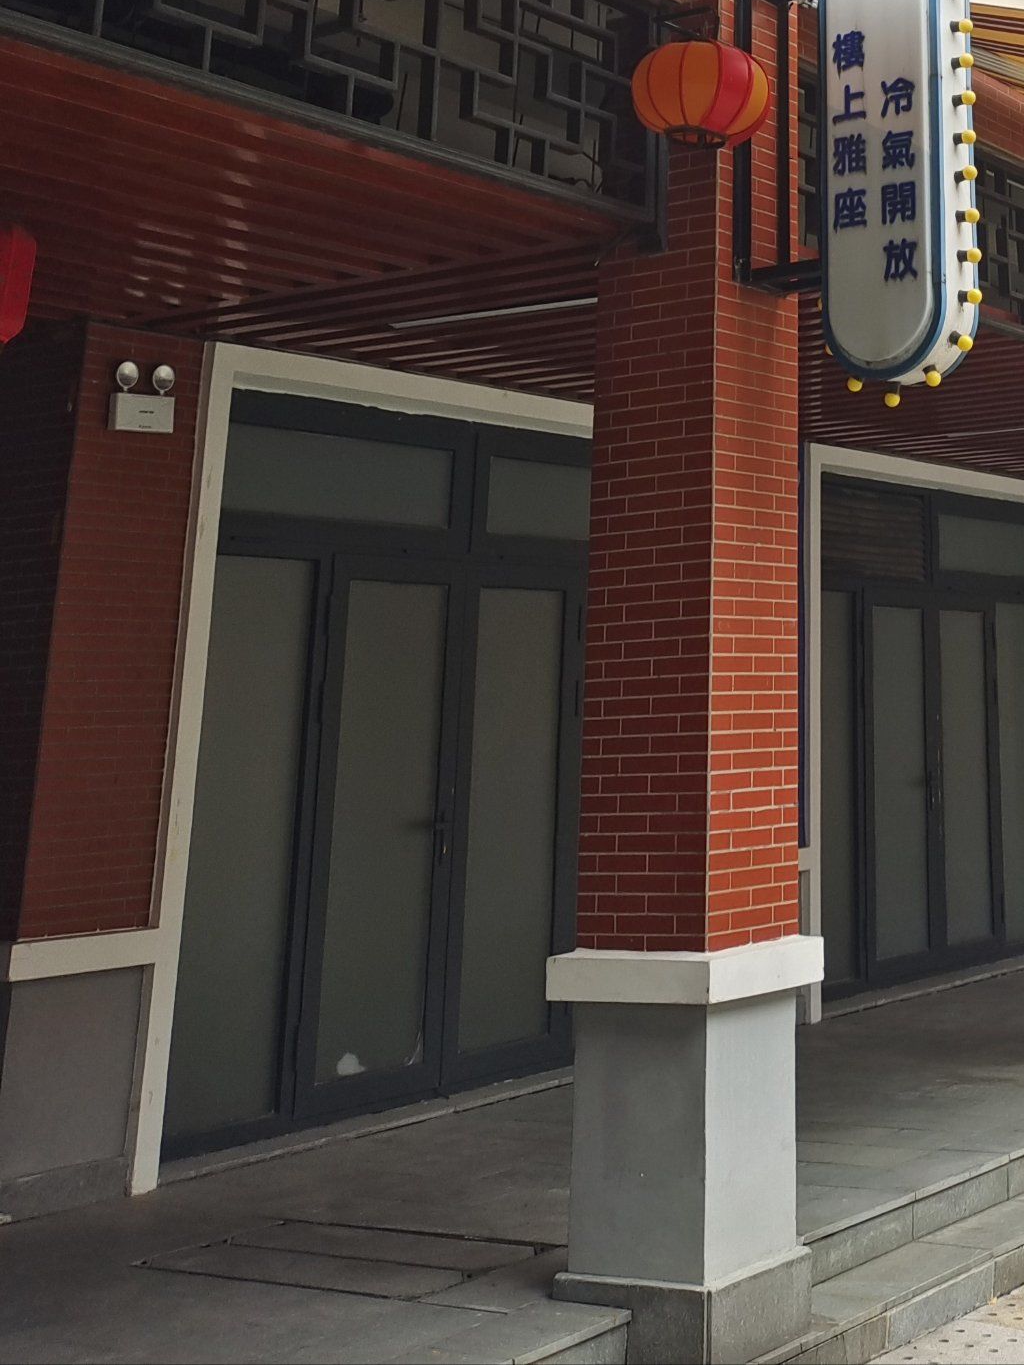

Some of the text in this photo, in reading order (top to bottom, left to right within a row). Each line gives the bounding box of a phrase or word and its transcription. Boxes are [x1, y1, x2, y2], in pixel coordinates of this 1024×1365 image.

[831, 30, 868, 231] 樓上雅座
[880, 76, 918, 282] 冷氣開放
